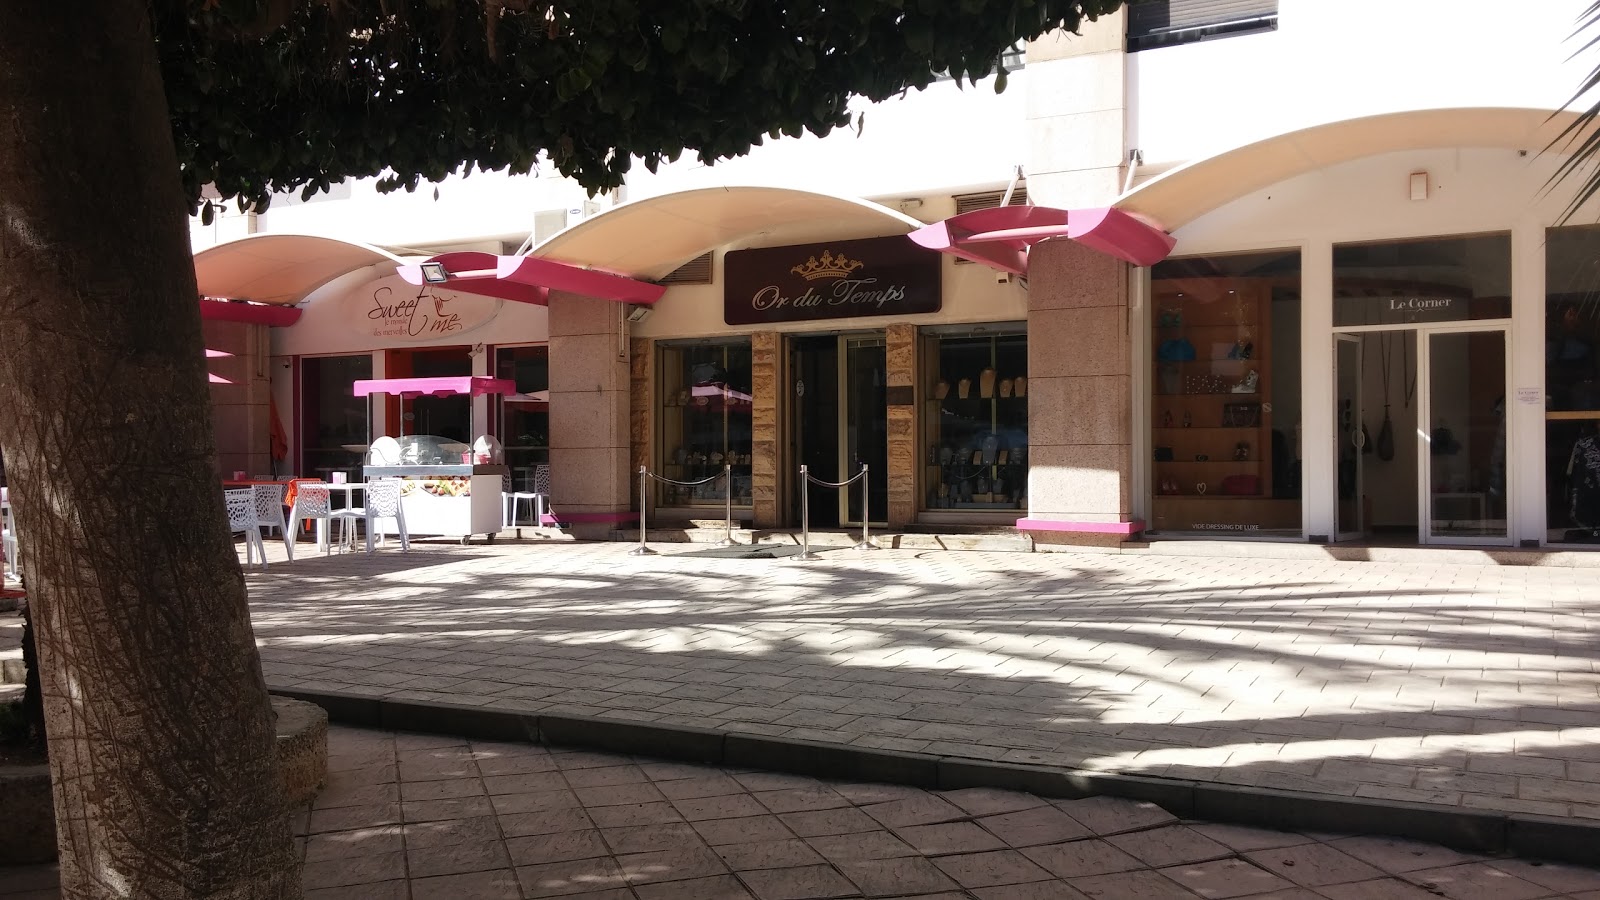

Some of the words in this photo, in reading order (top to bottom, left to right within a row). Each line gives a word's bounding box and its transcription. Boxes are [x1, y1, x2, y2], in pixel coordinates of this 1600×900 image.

[752, 285, 789, 311] Or
[793, 287, 823, 308] du
[827, 277, 906, 309] Temps
[1390, 299, 1406, 310] Le
[1408, 298, 1452, 309] Corner
[367, 285, 430, 337] Sweet
[430, 313, 463, 333] me
